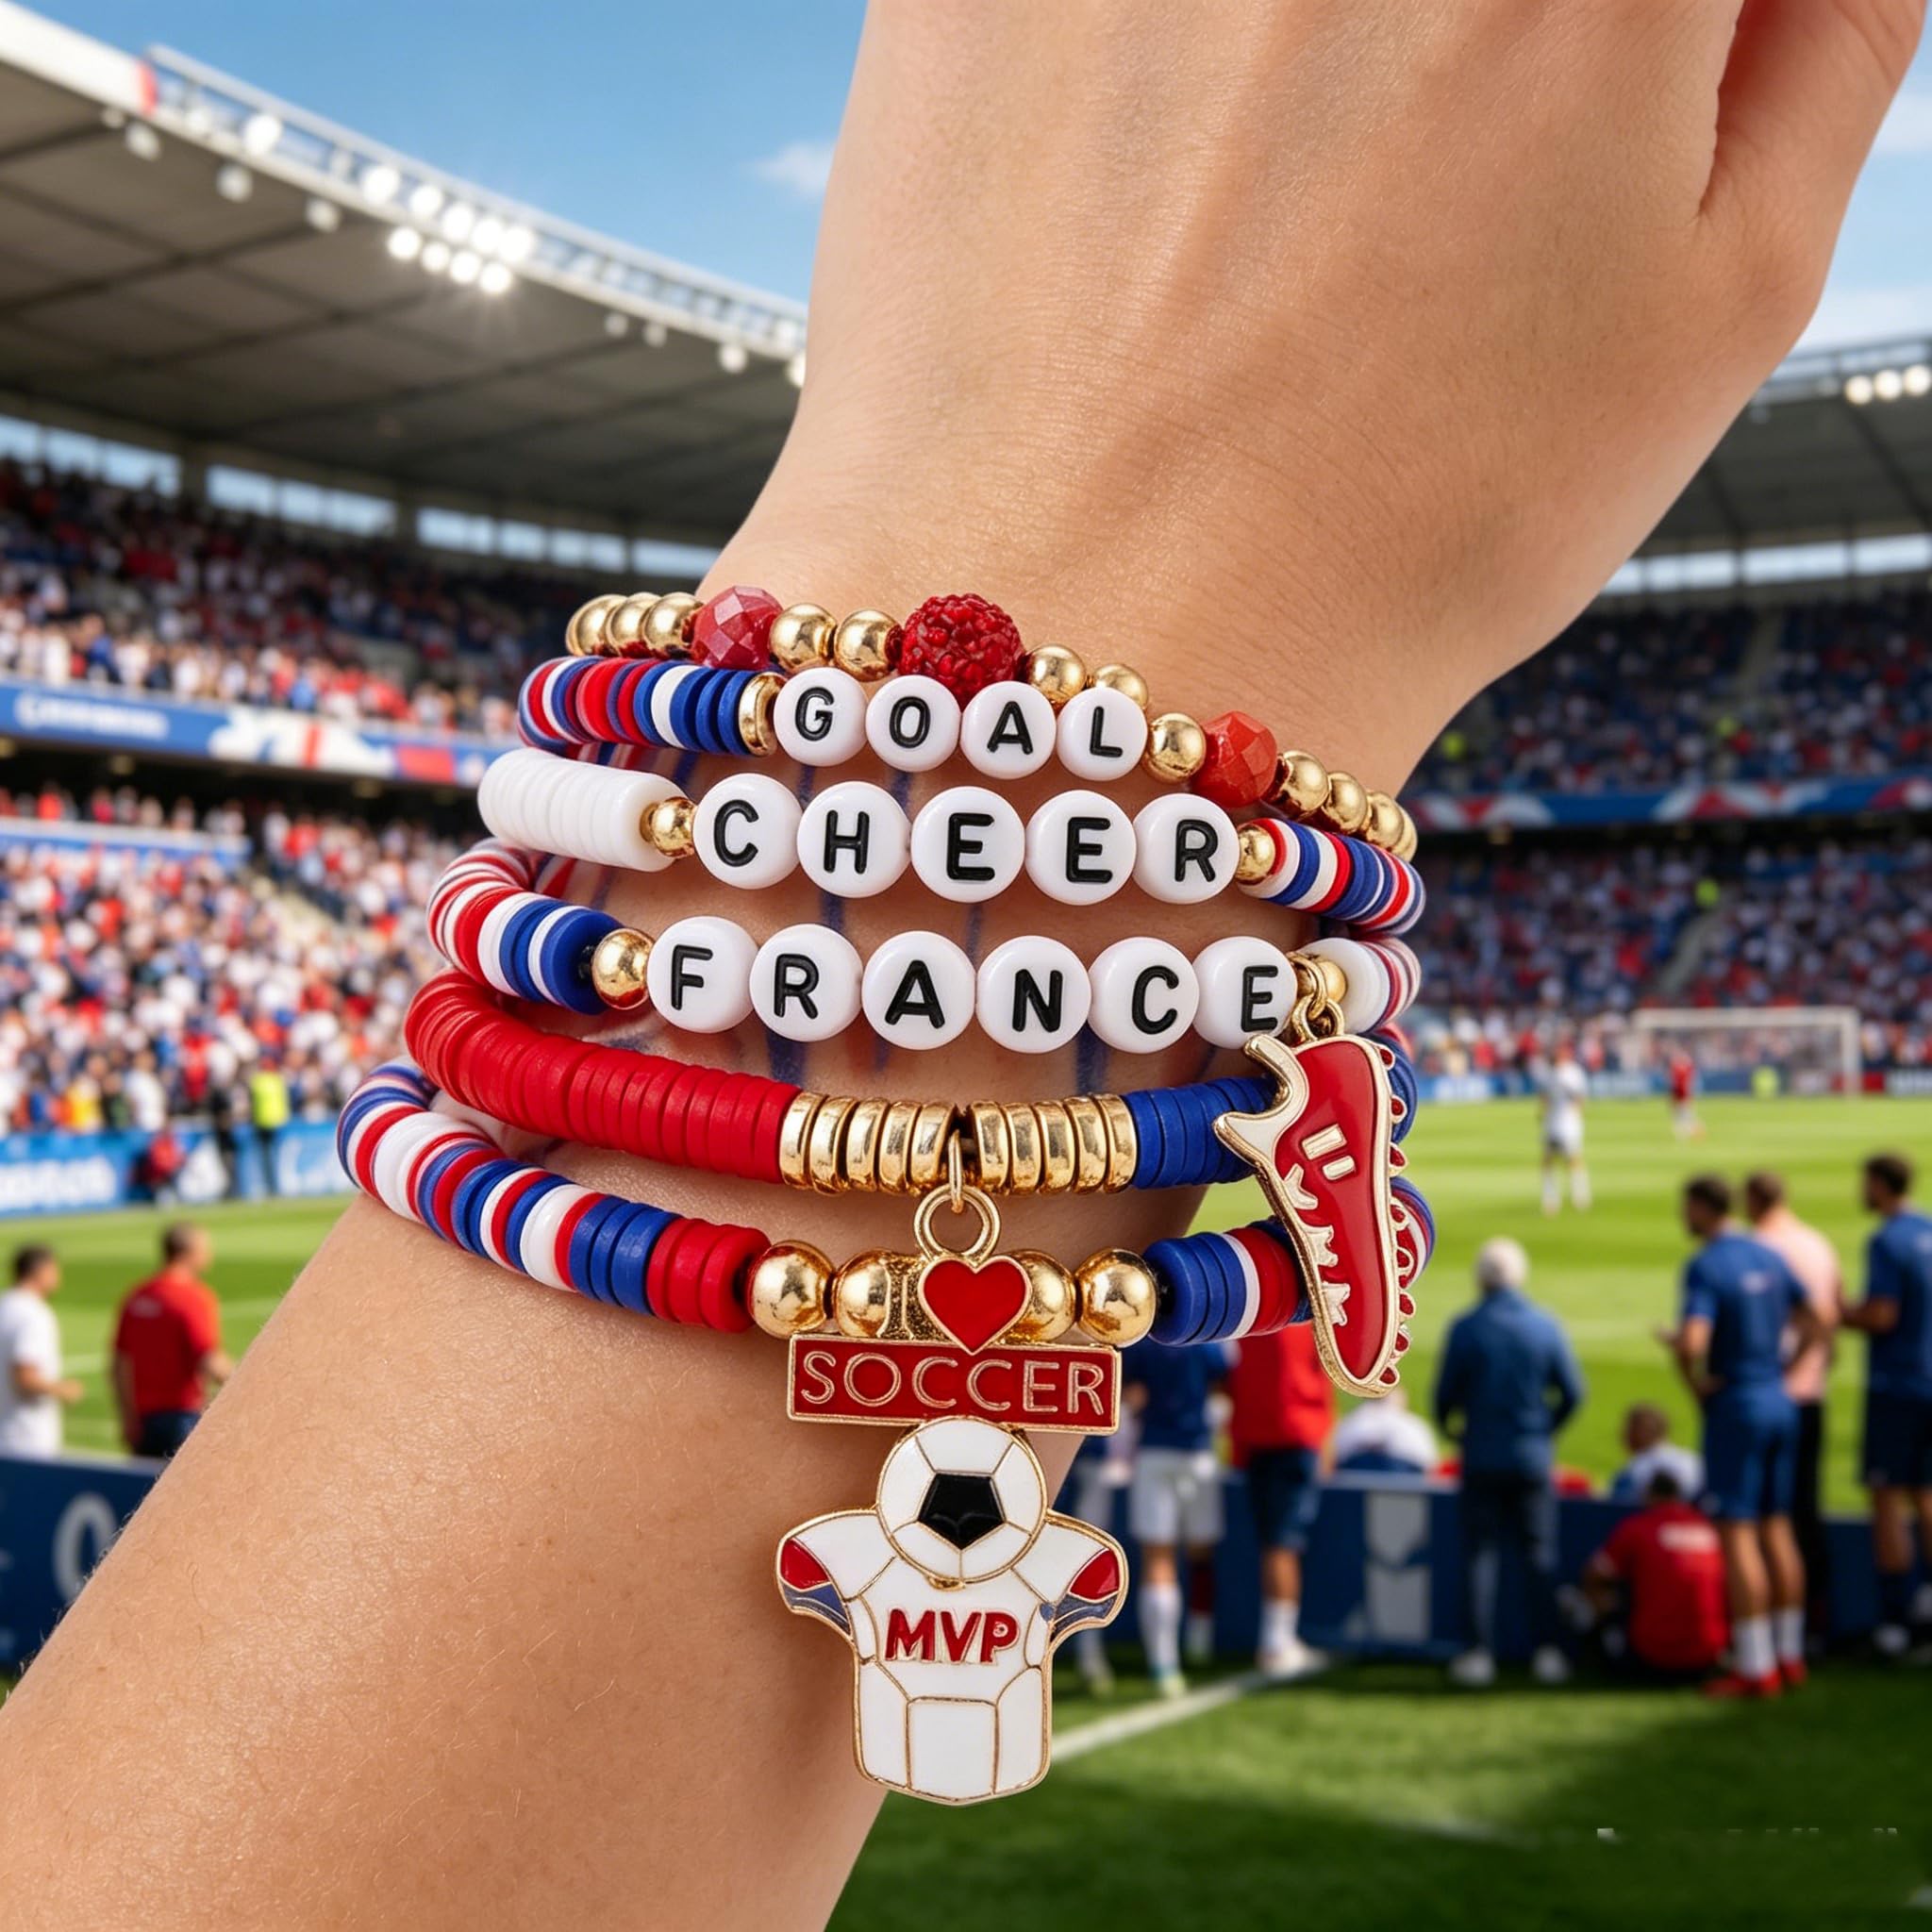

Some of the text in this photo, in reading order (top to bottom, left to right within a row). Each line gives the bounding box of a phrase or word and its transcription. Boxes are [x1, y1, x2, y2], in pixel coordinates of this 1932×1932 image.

[794, 686, 1123, 758] GOAL
[713, 799, 1218, 884] CHEER
[671, 944, 1279, 1034] FRANCE
[801, 1350, 1105, 1416] SOCCER
[884, 1607, 1021, 1665] MVP
